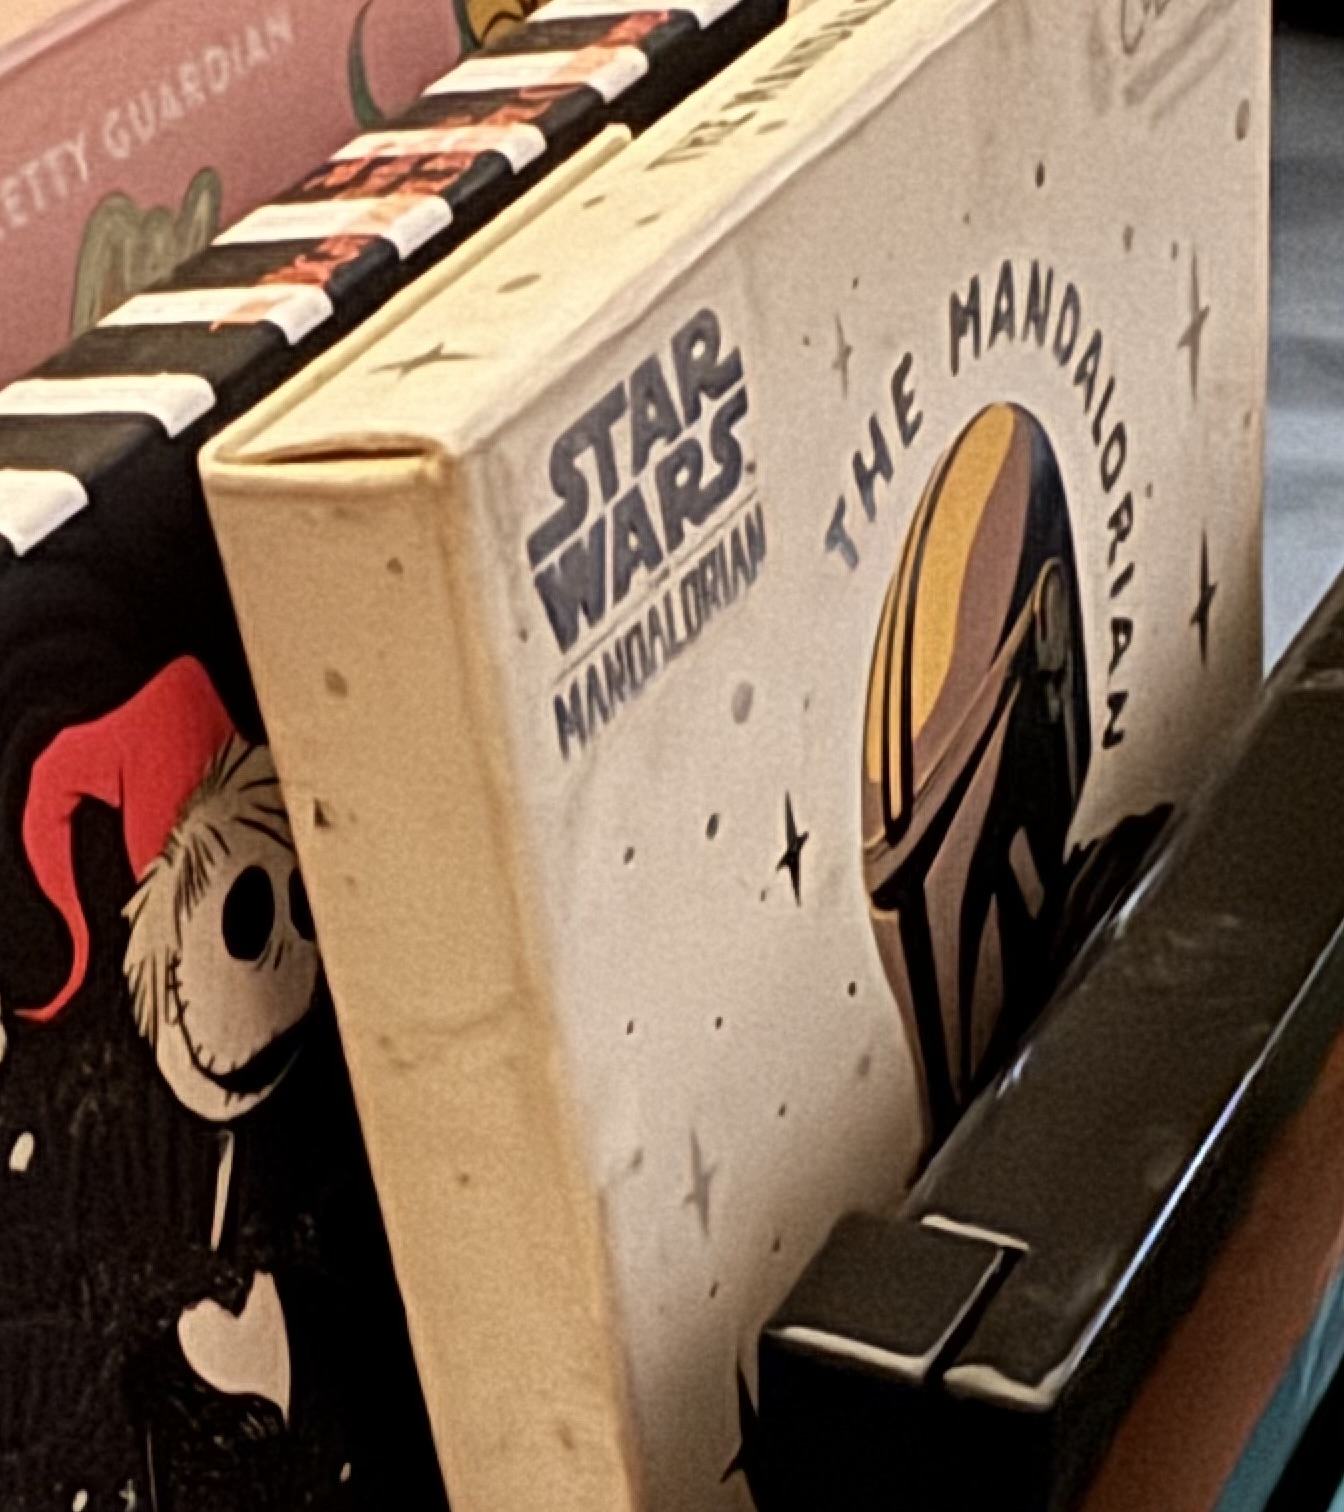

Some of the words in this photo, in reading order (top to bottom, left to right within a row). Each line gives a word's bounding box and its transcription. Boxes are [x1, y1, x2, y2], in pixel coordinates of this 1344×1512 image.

[101, 13, 296, 160] GUARDIAN
[526, 307, 745, 571] STAR
[533, 384, 749, 655] WARS
[824, 351, 924, 570] THE
[949, 258, 1135, 751] MANDALORIAN
[552, 501, 767, 761] MANDALORIAN
